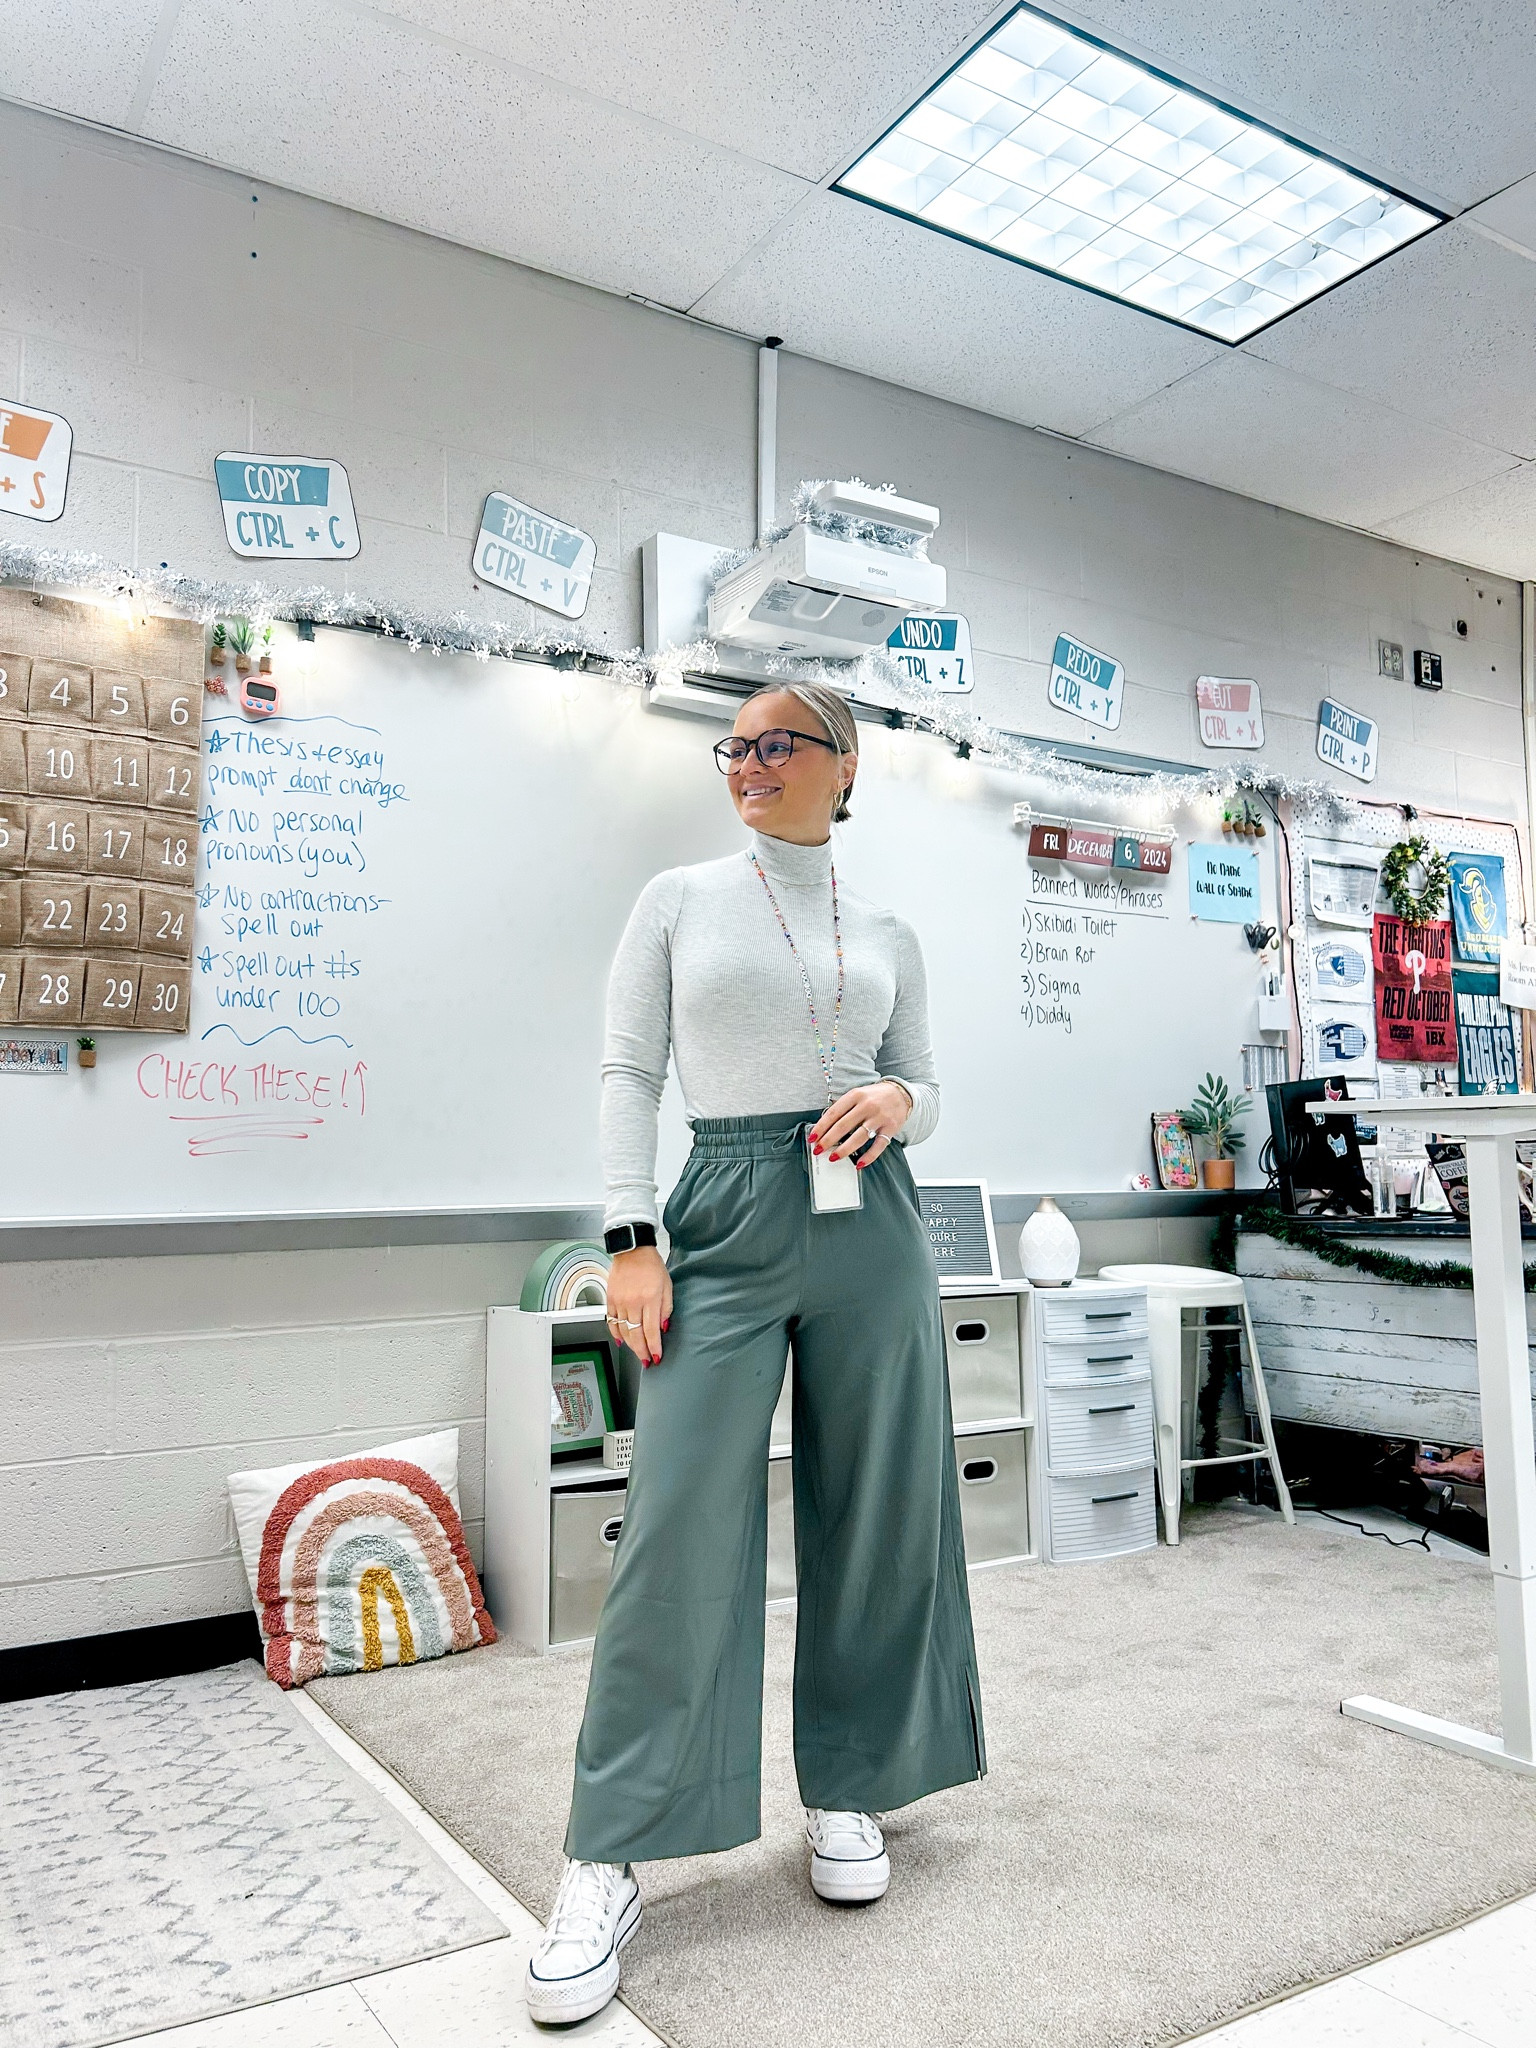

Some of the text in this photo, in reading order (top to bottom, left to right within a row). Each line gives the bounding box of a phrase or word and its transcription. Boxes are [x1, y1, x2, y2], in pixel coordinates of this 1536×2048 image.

[30, 471, 46, 509] S
[244, 464, 301, 502] COPY
[236, 511, 345, 549] CTRL + C
[502, 507, 558, 560] PASTE
[482, 542, 578, 607] CTRL + V
[868, 566, 888, 577] EPSON
[900, 619, 943, 649] UNDO
[898, 655, 965, 684] TRL + Z
[1066, 643, 1100, 683] REDO
[49, 678, 71, 707] 4
[110, 685, 129, 715] 5
[170, 697, 189, 725] 6
[1054, 674, 1113, 721] CTRL + Y
[1212, 685, 1232, 709] CUT
[1205, 716, 1257, 742] CTRL + X
[1330, 708, 1359, 741] PRINT
[229, 731, 307, 760] Thesis
[327, 746, 384, 783] essay
[1322, 734, 1370, 773] CTRL + P
[45, 748, 191, 797] 10 11 12
[208, 764, 410, 808] prompt dont change
[228, 809, 362, 842] No personal
[46, 821, 76, 852] 16
[102, 829, 132, 859] 17
[161, 838, 188, 867] 18
[1143, 848, 1167, 868] 2024
[224, 884, 252, 911] No
[1032, 869, 1076, 897] Banned
[43, 899, 184, 940] 22 23 24
[290, 917, 323, 937] out
[1035, 912, 1077, 934] Skibidi
[1082, 916, 1117, 938] Toilet
[1036, 942, 1069, 963] Brain
[1075, 946, 1096, 964] Rot
[1378, 922, 1399, 955] THE
[275, 953, 315, 979] out
[1507, 972, 1526, 985] Room
[39, 974, 70, 1005] 28
[102, 978, 133, 1009] 29
[152, 983, 179, 1012] 30
[216, 985, 340, 1017] under 100
[1038, 973, 1081, 1002] Sigma
[1036, 1006, 1072, 1034] Diddy
[1382, 986, 1451, 1022] RED OCTOBER
[1426, 1031, 1446, 1046] IBX
[1460, 1026, 1515, 1084] EAGLES
[137, 1053, 348, 1108] CHECK THESE!
[925, 1218, 958, 1227] APPY
[931, 1203, 943, 1212] SO
[934, 1247, 957, 1257] ERE
[617, 1452, 631, 1460] TEAC
